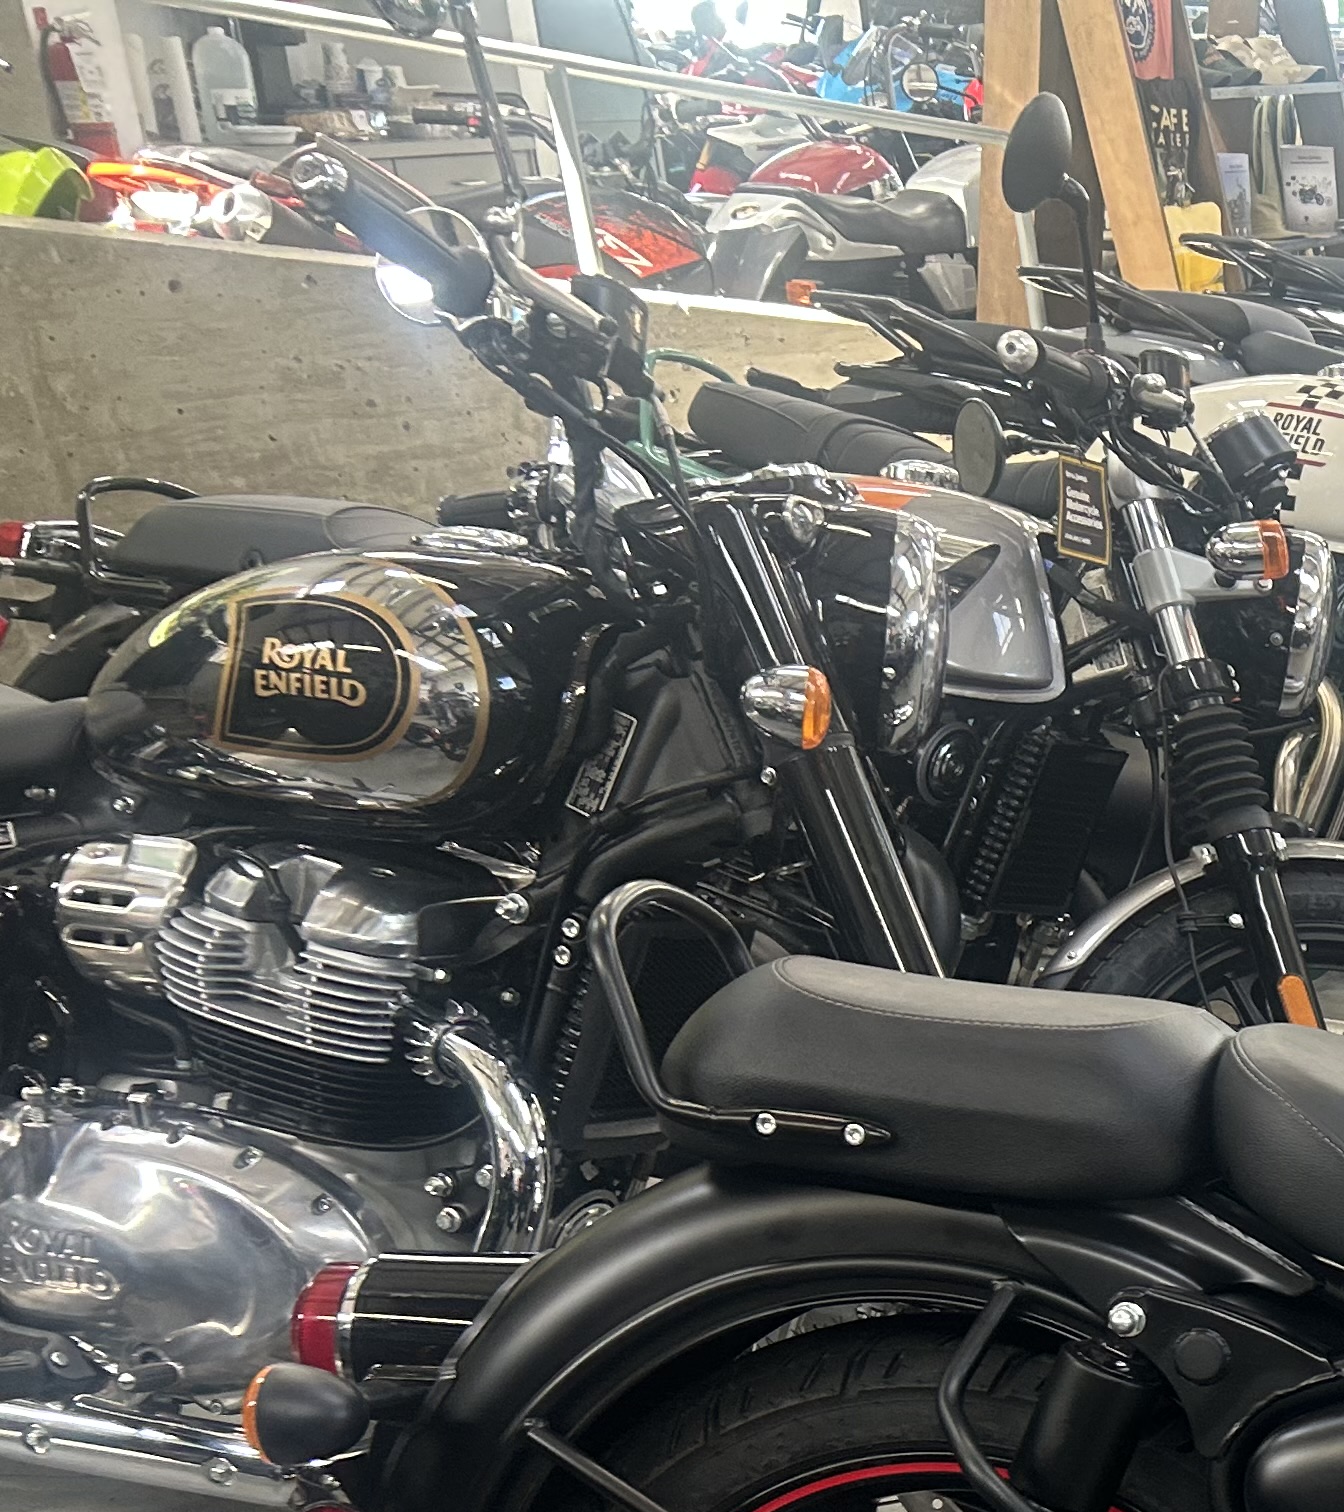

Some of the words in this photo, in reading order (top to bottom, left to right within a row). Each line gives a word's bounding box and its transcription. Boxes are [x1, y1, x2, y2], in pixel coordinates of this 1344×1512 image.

[1273, 412, 1323, 436] ROYAL
[262, 637, 353, 673] ROYAL
[254, 668, 367, 707] ENFIELD
